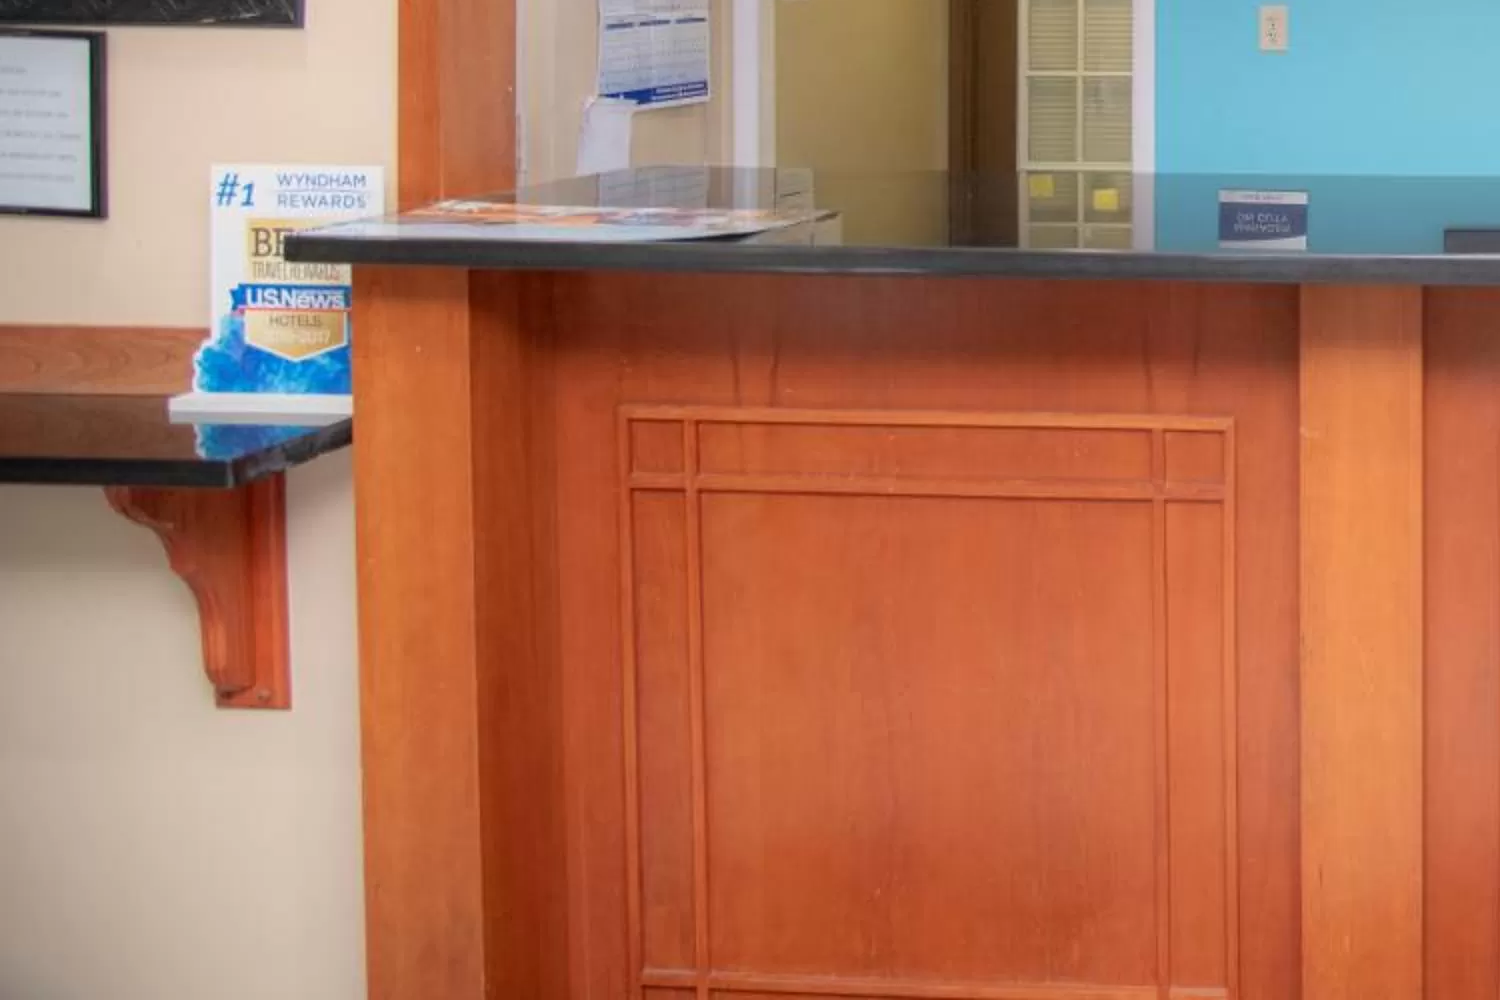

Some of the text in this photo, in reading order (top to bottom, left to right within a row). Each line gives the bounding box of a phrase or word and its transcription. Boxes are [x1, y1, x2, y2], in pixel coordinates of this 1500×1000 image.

[276, 173, 367, 188] WYNDHAM
[215, 172, 256, 208] #1
[277, 193, 367, 209] REWARDS
[269, 314, 322, 328] HOTELS
